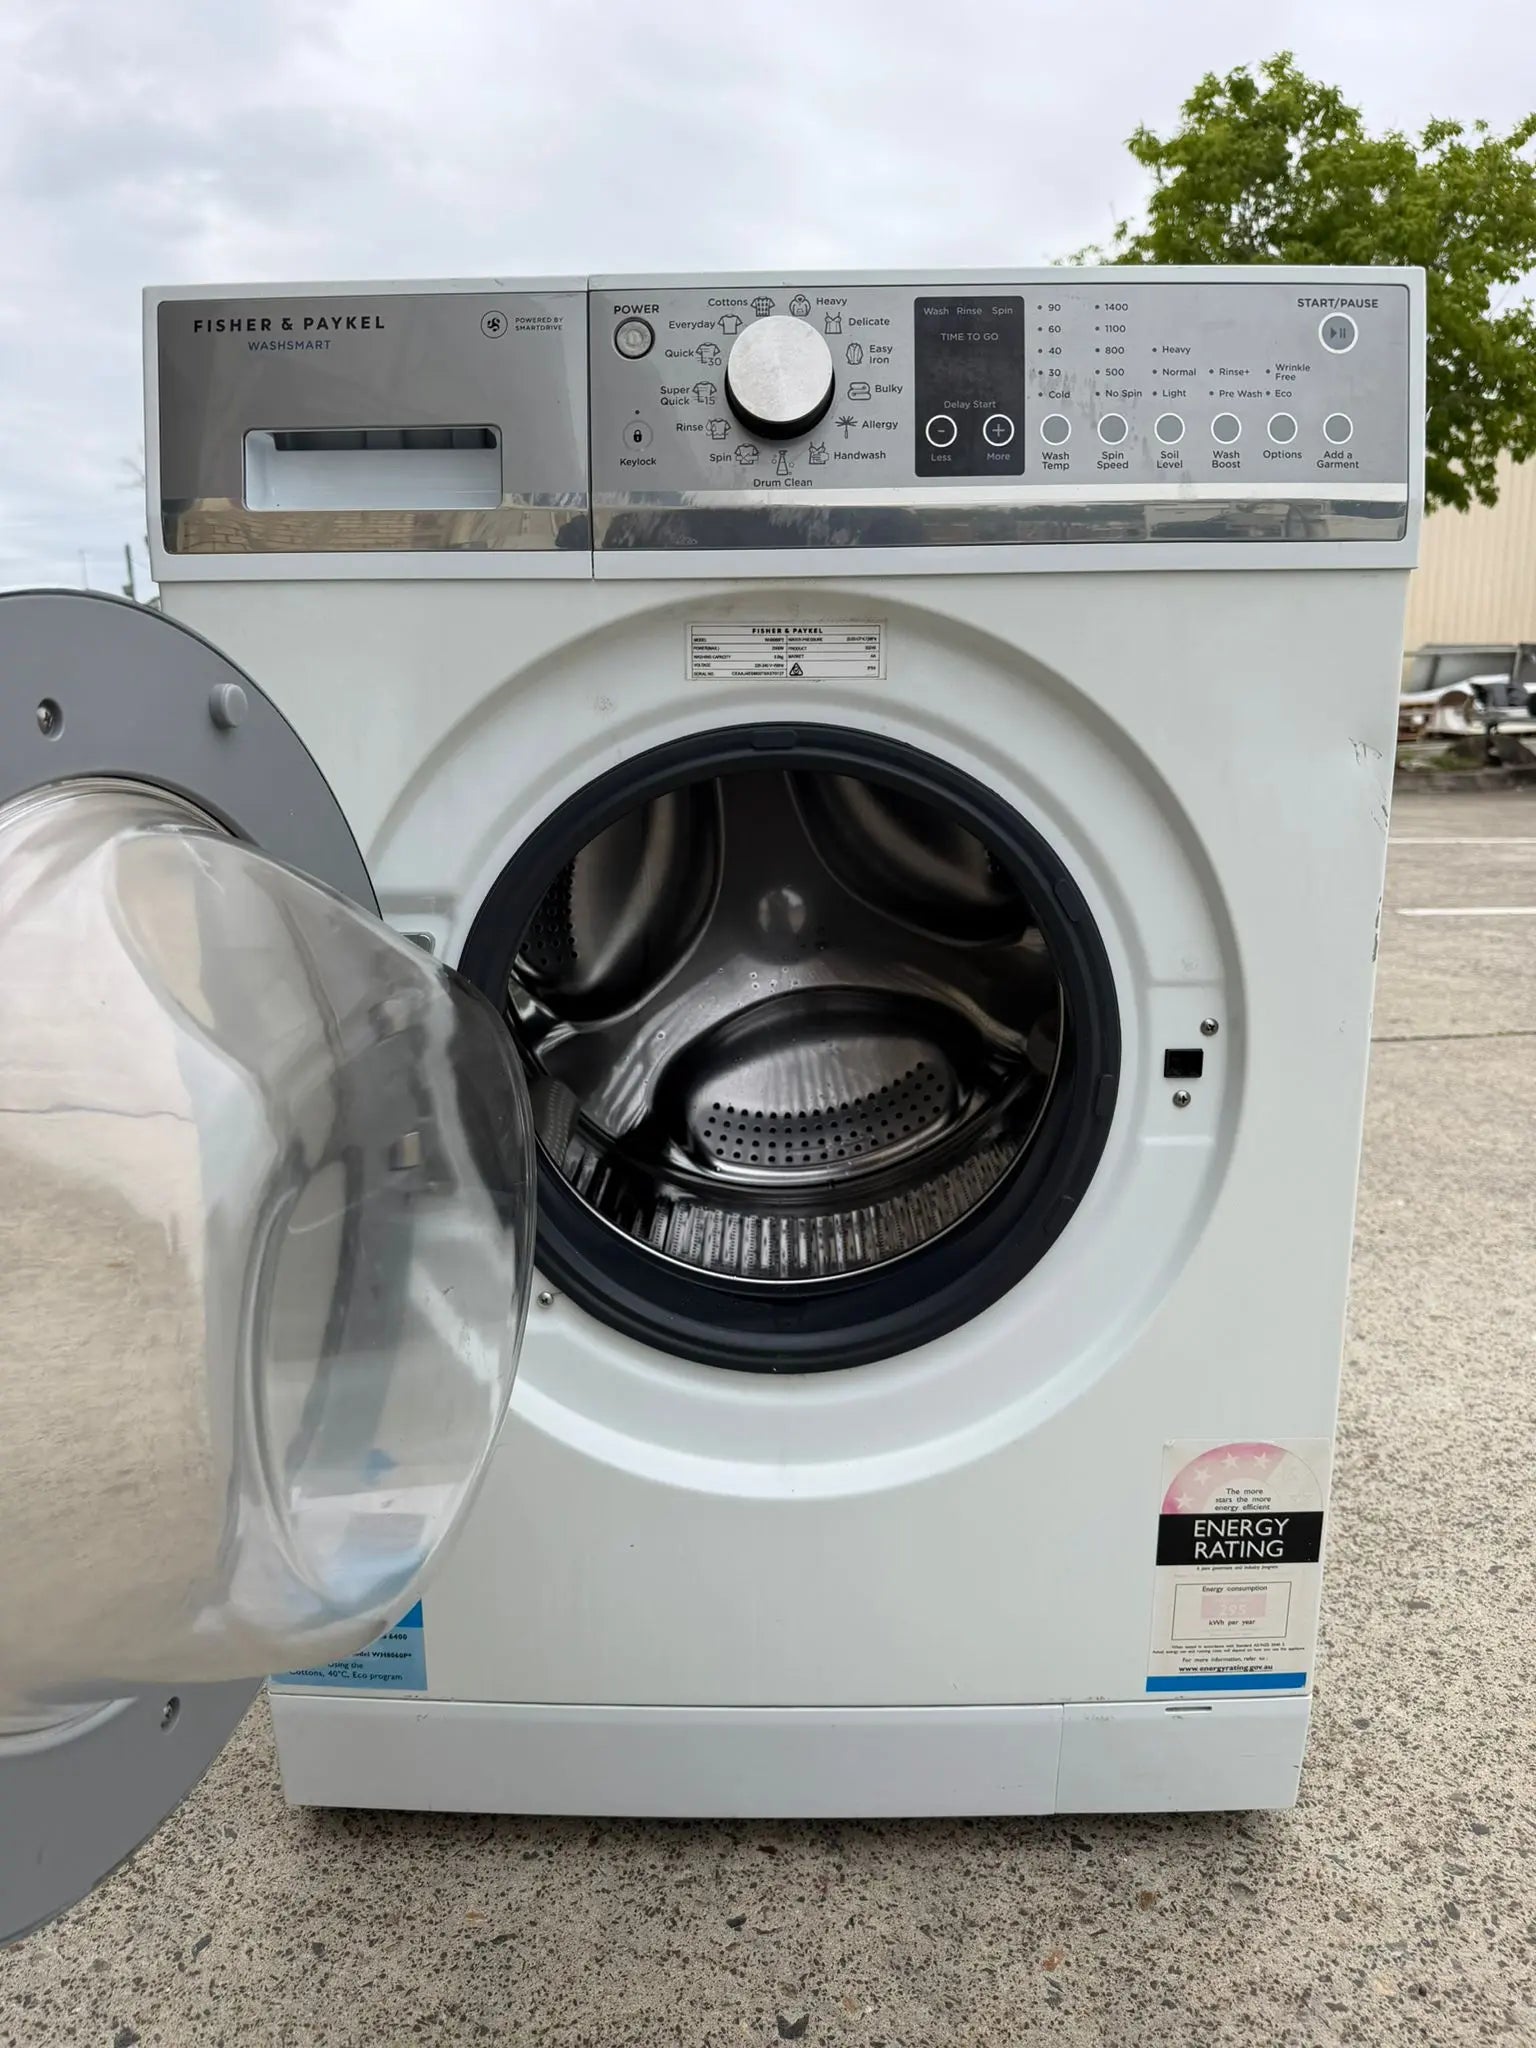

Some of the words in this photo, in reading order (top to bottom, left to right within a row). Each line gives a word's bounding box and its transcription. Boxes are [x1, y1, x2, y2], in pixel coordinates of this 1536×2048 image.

[708, 298, 748, 307] Cottons
[816, 297, 847, 306] Heavy
[1297, 297, 1379, 309] START/PAUSE
[614, 304, 660, 314] POWER
[923, 307, 949, 316] Wash
[956, 306, 983, 315] Rinse
[992, 306, 1013, 316] Spin
[1048, 304, 1061, 312] 90
[1104, 303, 1129, 311] 1400
[194, 318, 272, 333] FISHER
[281, 317, 293, 331] &
[304, 316, 385, 330] PAYKEL
[668, 320, 716, 330] Everyday
[848, 318, 891, 326] Delicate
[1048, 325, 1062, 333] 60
[1104, 324, 1126, 333] 1100
[940, 333, 964, 341] TIME
[966, 333, 981, 341] TO
[983, 333, 999, 341] GO
[248, 340, 331, 351] WASHSMART
[869, 345, 893, 354] Easy
[665, 349, 694, 358] Quick
[1048, 347, 1062, 355] 40
[1104, 346, 1125, 355] 800
[1162, 346, 1191, 355] Heavy
[869, 356, 890, 364] Iron
[1105, 368, 1125, 376] 500
[1162, 368, 1197, 376] Normal
[1219, 368, 1250, 376] Rinse+
[1275, 363, 1311, 372] Wrinkle
[1048, 369, 1061, 377] 30
[1275, 373, 1296, 381] Free
[660, 385, 690, 396] Super
[875, 384, 903, 394] Bulky
[1162, 389, 1187, 398] Light
[1219, 390, 1234, 398] Pre
[1237, 389, 1263, 398] Wash
[1275, 389, 1292, 398] Eco
[1048, 390, 1071, 399] Cold
[1105, 389, 1119, 397] No
[1121, 389, 1143, 399] Spin
[660, 396, 690, 406] Quick
[943, 400, 971, 410] Delay
[973, 400, 996, 409] Start
[676, 423, 704, 432] Rinse
[861, 420, 899, 430] Allergy
[709, 453, 732, 463] Spin
[833, 451, 886, 460] Handwash
[931, 453, 952, 462] Less
[987, 452, 1011, 461] More
[1041, 451, 1070, 460] Wash
[1102, 451, 1124, 461] Spin
[1160, 450, 1179, 459] Soil
[1212, 450, 1240, 459] Wash
[1262, 450, 1303, 460] Options
[1323, 451, 1344, 459] Add
[620, 457, 657, 467] Keylock
[1041, 461, 1070, 471] Temp
[1096, 460, 1129, 470] Speed
[1156, 460, 1183, 469] Level
[1212, 460, 1241, 469] Boost
[1316, 460, 1359, 469] Garment
[753, 478, 781, 487] Drum
[784, 478, 813, 487] Clean
[1193, 1518, 1290, 1537] ENERGY
[1194, 1540, 1284, 1559] RATING
[1202, 1585, 1223, 1593] Energy
[1178, 1664, 1273, 1672] www.energyrating.gov.au
[352, 1671, 368, 1679] Eco
[370, 1673, 403, 1682] program
